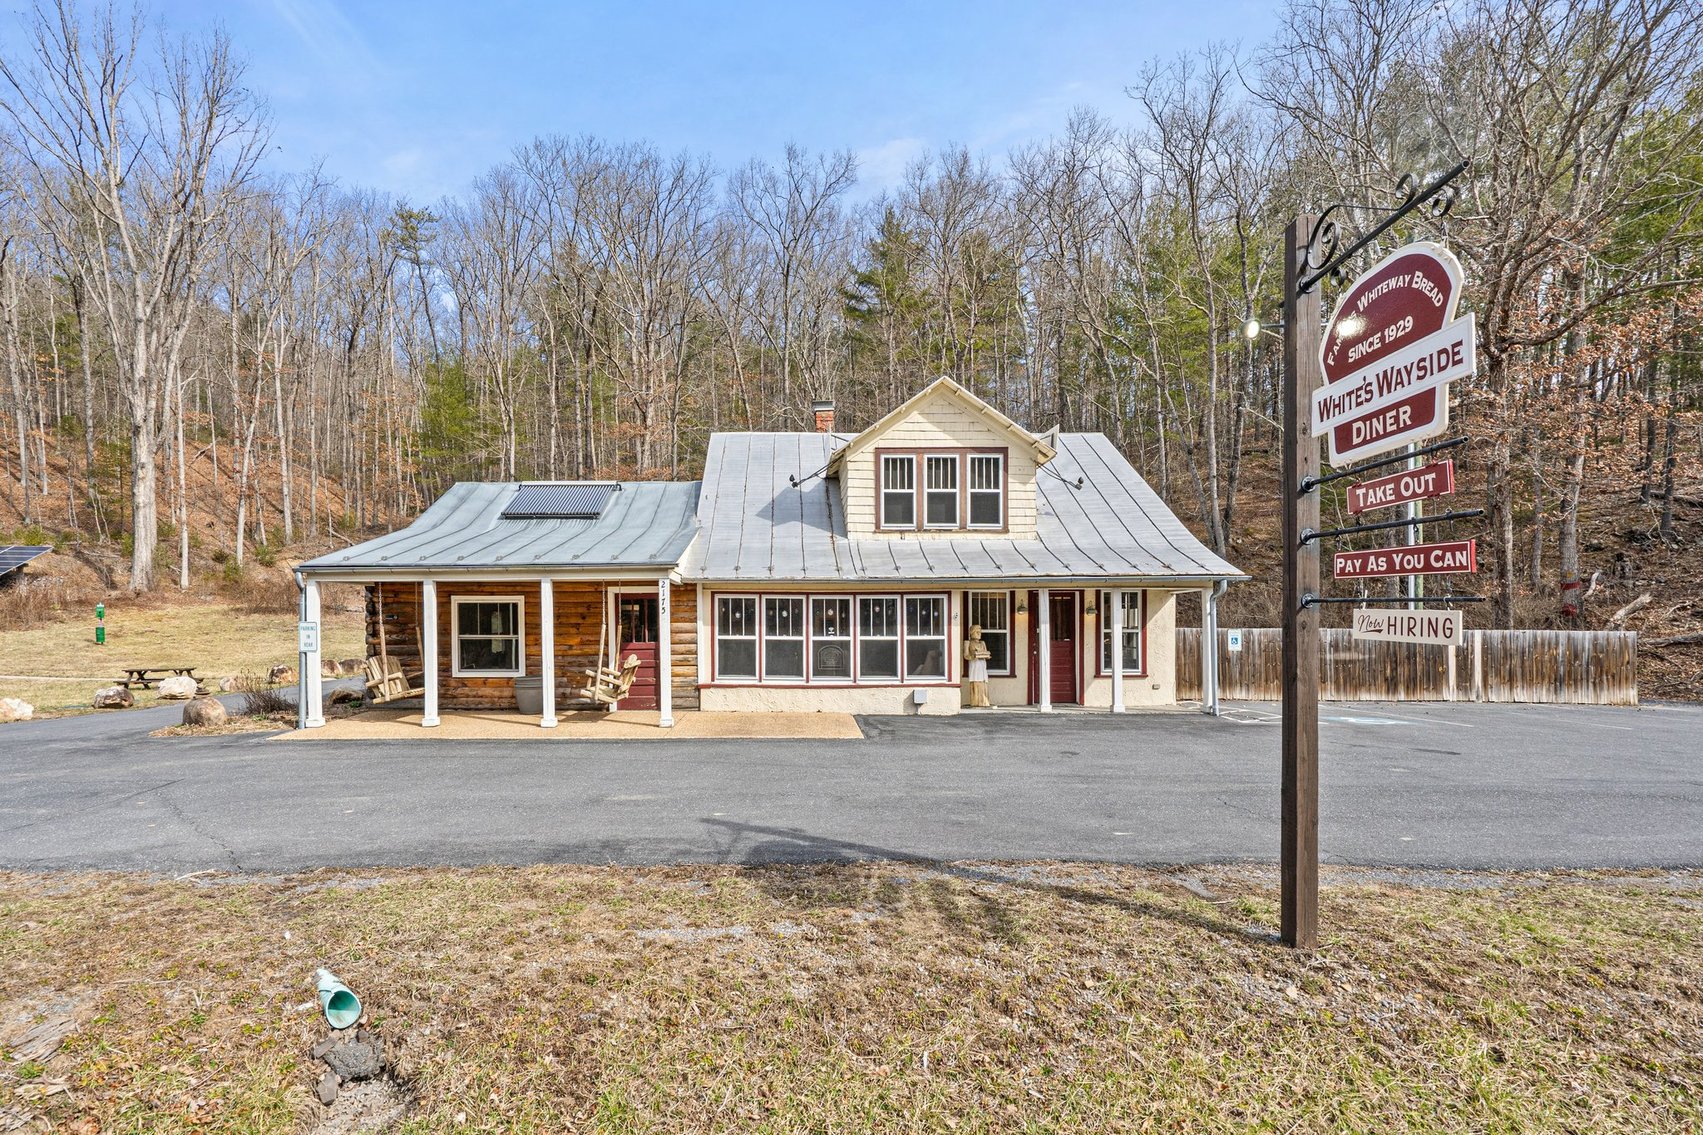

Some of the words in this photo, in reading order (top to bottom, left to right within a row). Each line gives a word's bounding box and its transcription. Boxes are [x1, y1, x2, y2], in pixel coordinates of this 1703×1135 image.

[1357, 274, 1412, 313] WHITEWAY
[1412, 270, 1444, 308] BREAD
[1347, 332, 1382, 363] SINCE
[1384, 315, 1414, 343] 1929
[1317, 375, 1374, 423] WHITE'S
[1375, 339, 1464, 398] WAYSIDE
[1352, 405, 1412, 446] DINER
[1355, 482, 1396, 507] TAKE
[1400, 472, 1436, 497] OUT
[1336, 557, 1362, 574] PAY
[1367, 555, 1387, 571] AS
[1392, 553, 1425, 570] YOU
[1430, 550, 1467, 568] CAN
[1357, 614, 1384, 632] Now
[1387, 616, 1453, 639] HIRING
